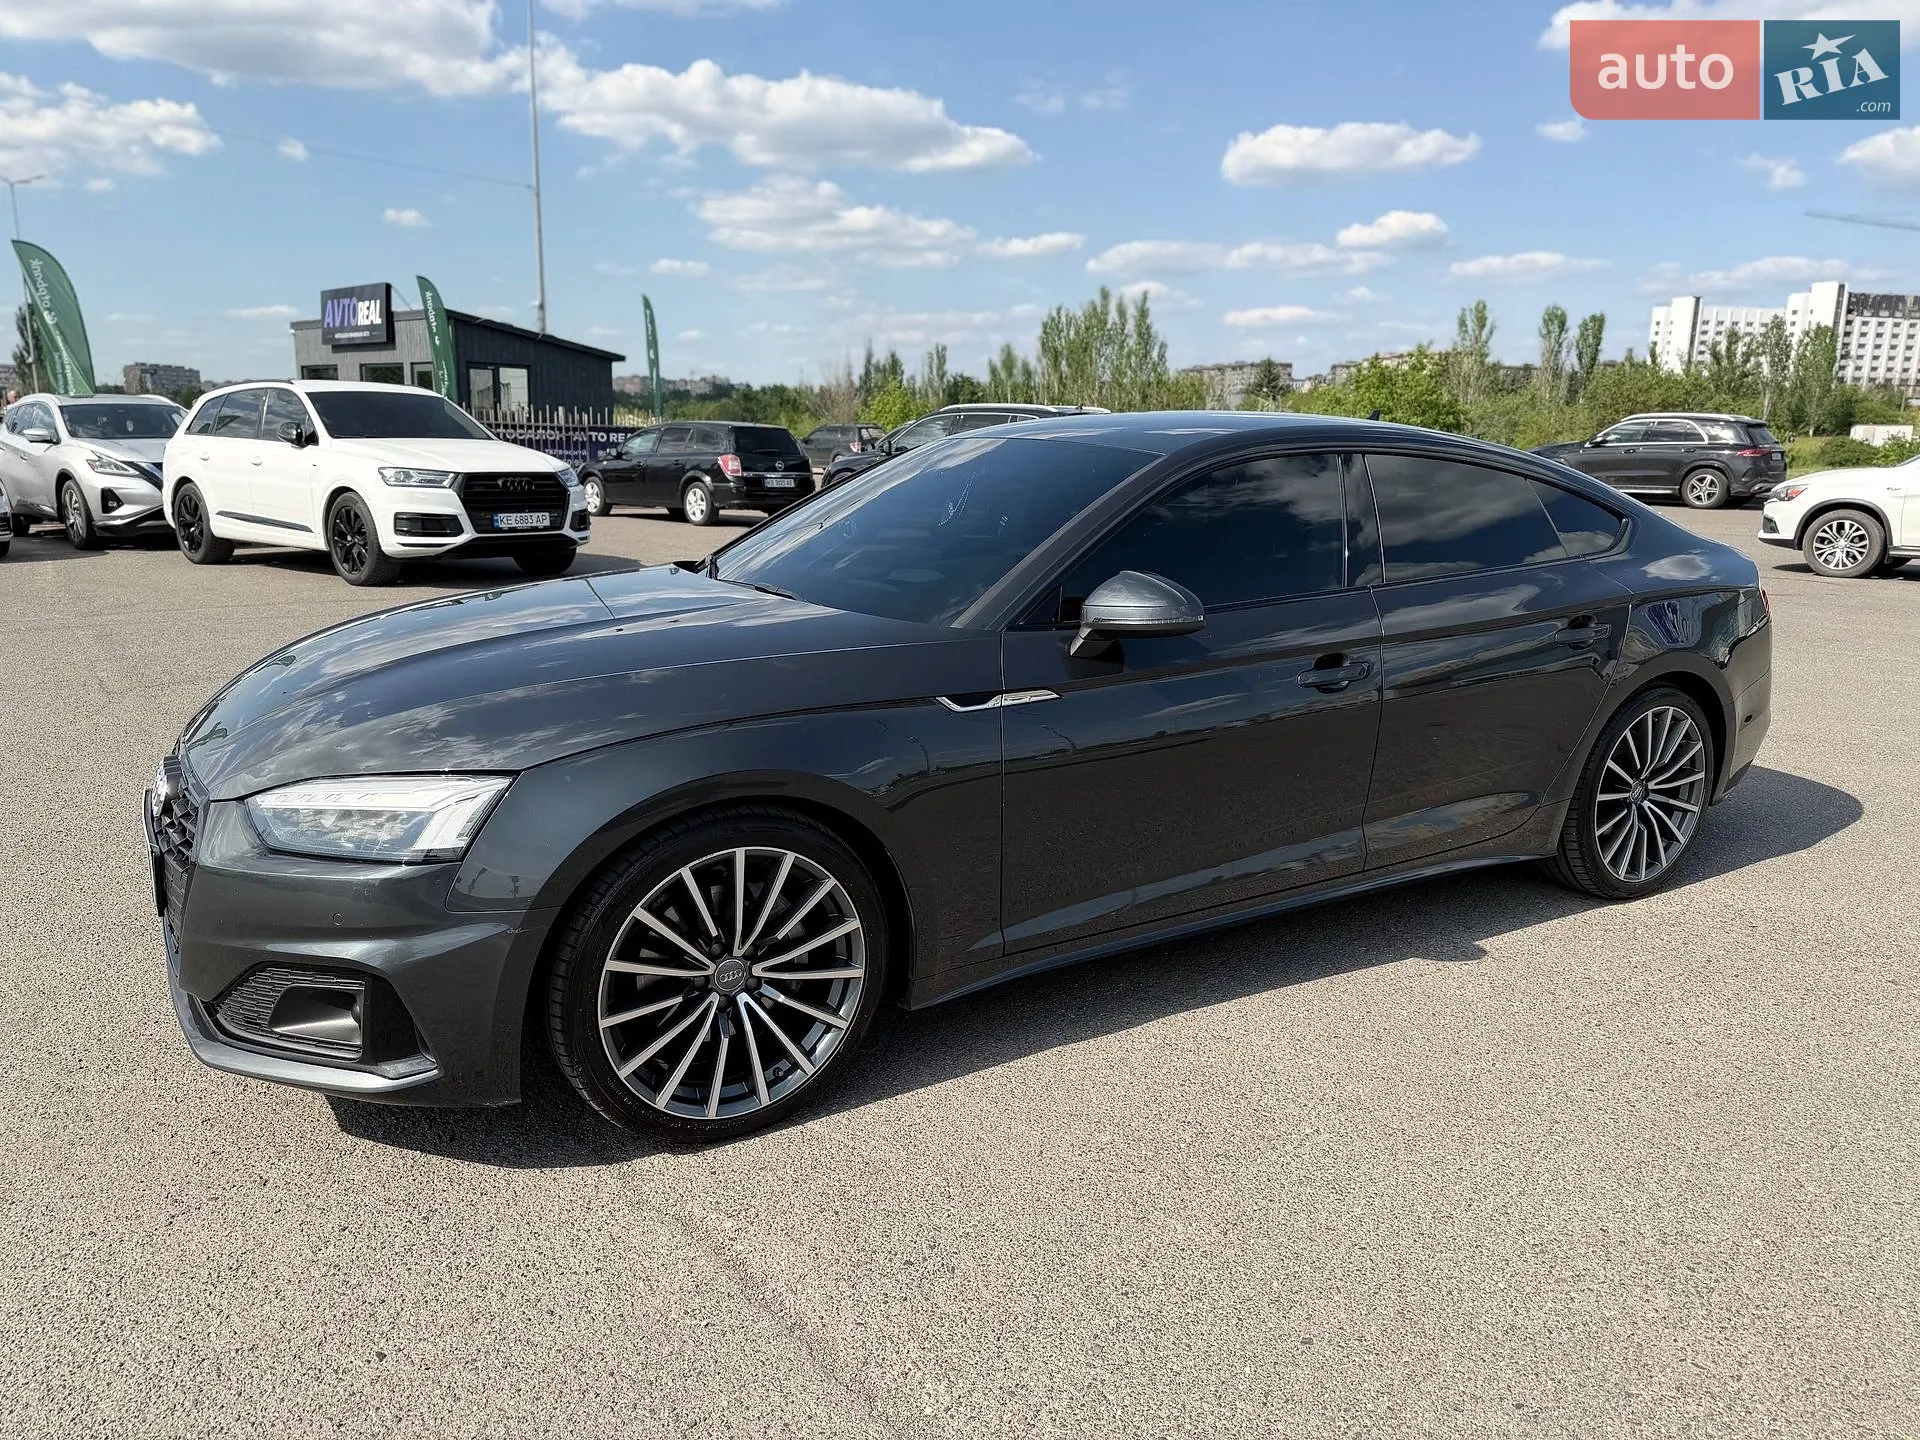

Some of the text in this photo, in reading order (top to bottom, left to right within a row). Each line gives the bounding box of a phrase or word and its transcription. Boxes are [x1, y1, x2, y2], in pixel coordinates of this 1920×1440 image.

[494, 428, 565, 441] ТОСАЛОН
[499, 513, 548, 526] KE 6883 AP
